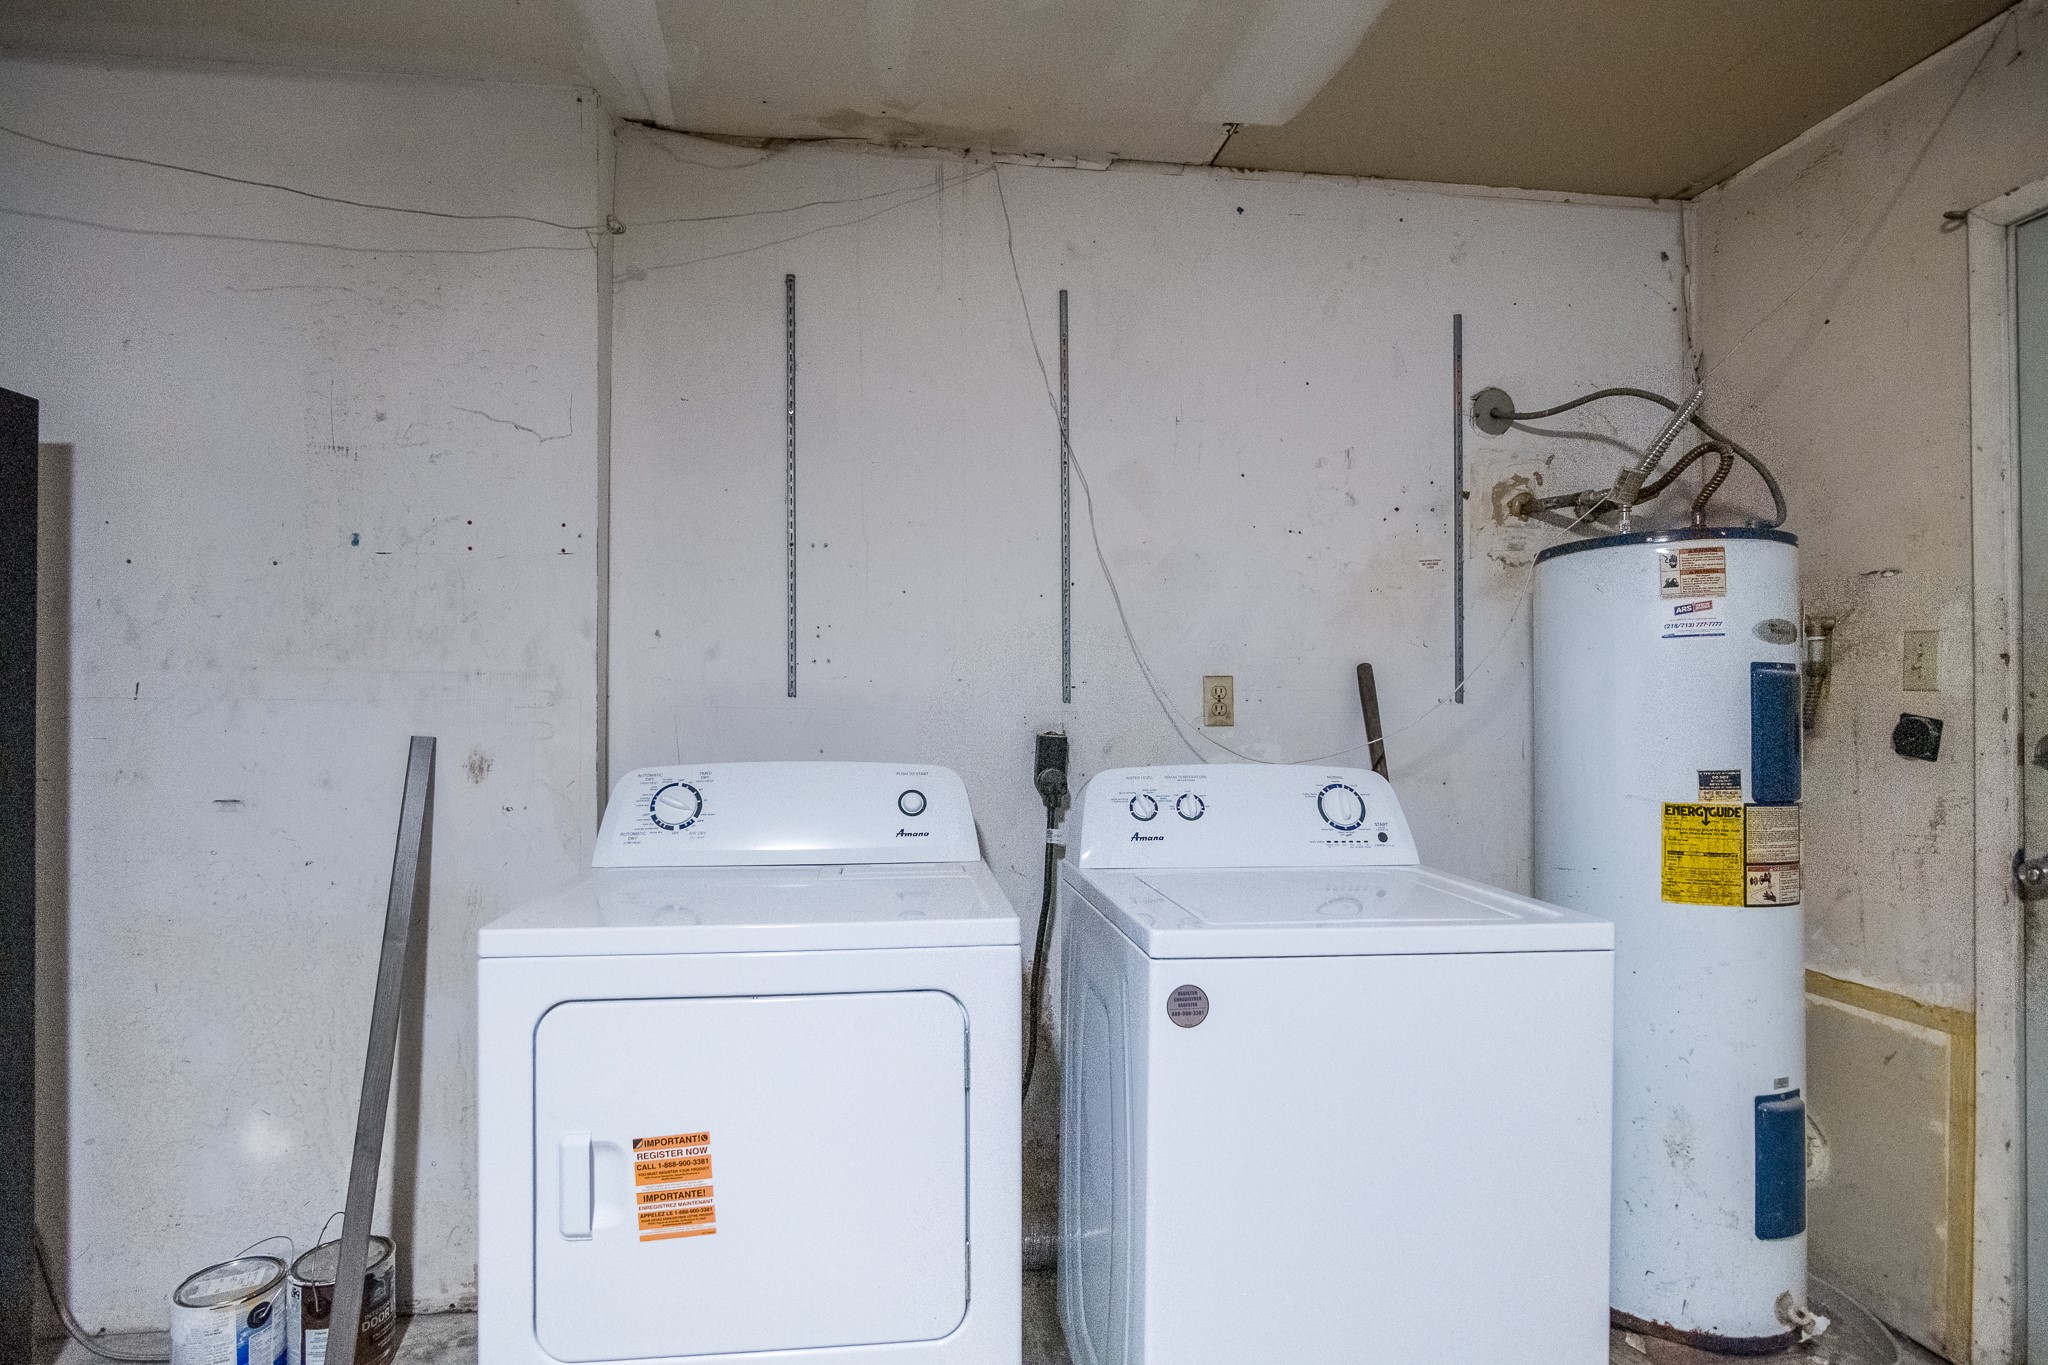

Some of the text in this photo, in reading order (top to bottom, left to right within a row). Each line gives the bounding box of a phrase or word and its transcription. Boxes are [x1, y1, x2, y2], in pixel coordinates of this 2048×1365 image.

[1675, 605, 1692, 613] ARS
[896, 829, 929, 837] Amana
[1131, 832, 1164, 841] Amana
[644, 1135, 700, 1147] IMPORTANT!
[637, 1147, 708, 1160] REGISTER NOW
[636, 1158, 709, 1171] CALL 1-888-900-3381
[643, 1189, 706, 1202] IMPORTANTE!
[638, 1203, 677, 1211] ENREGISTREZ
[362, 1307, 390, 1332] DOOR
